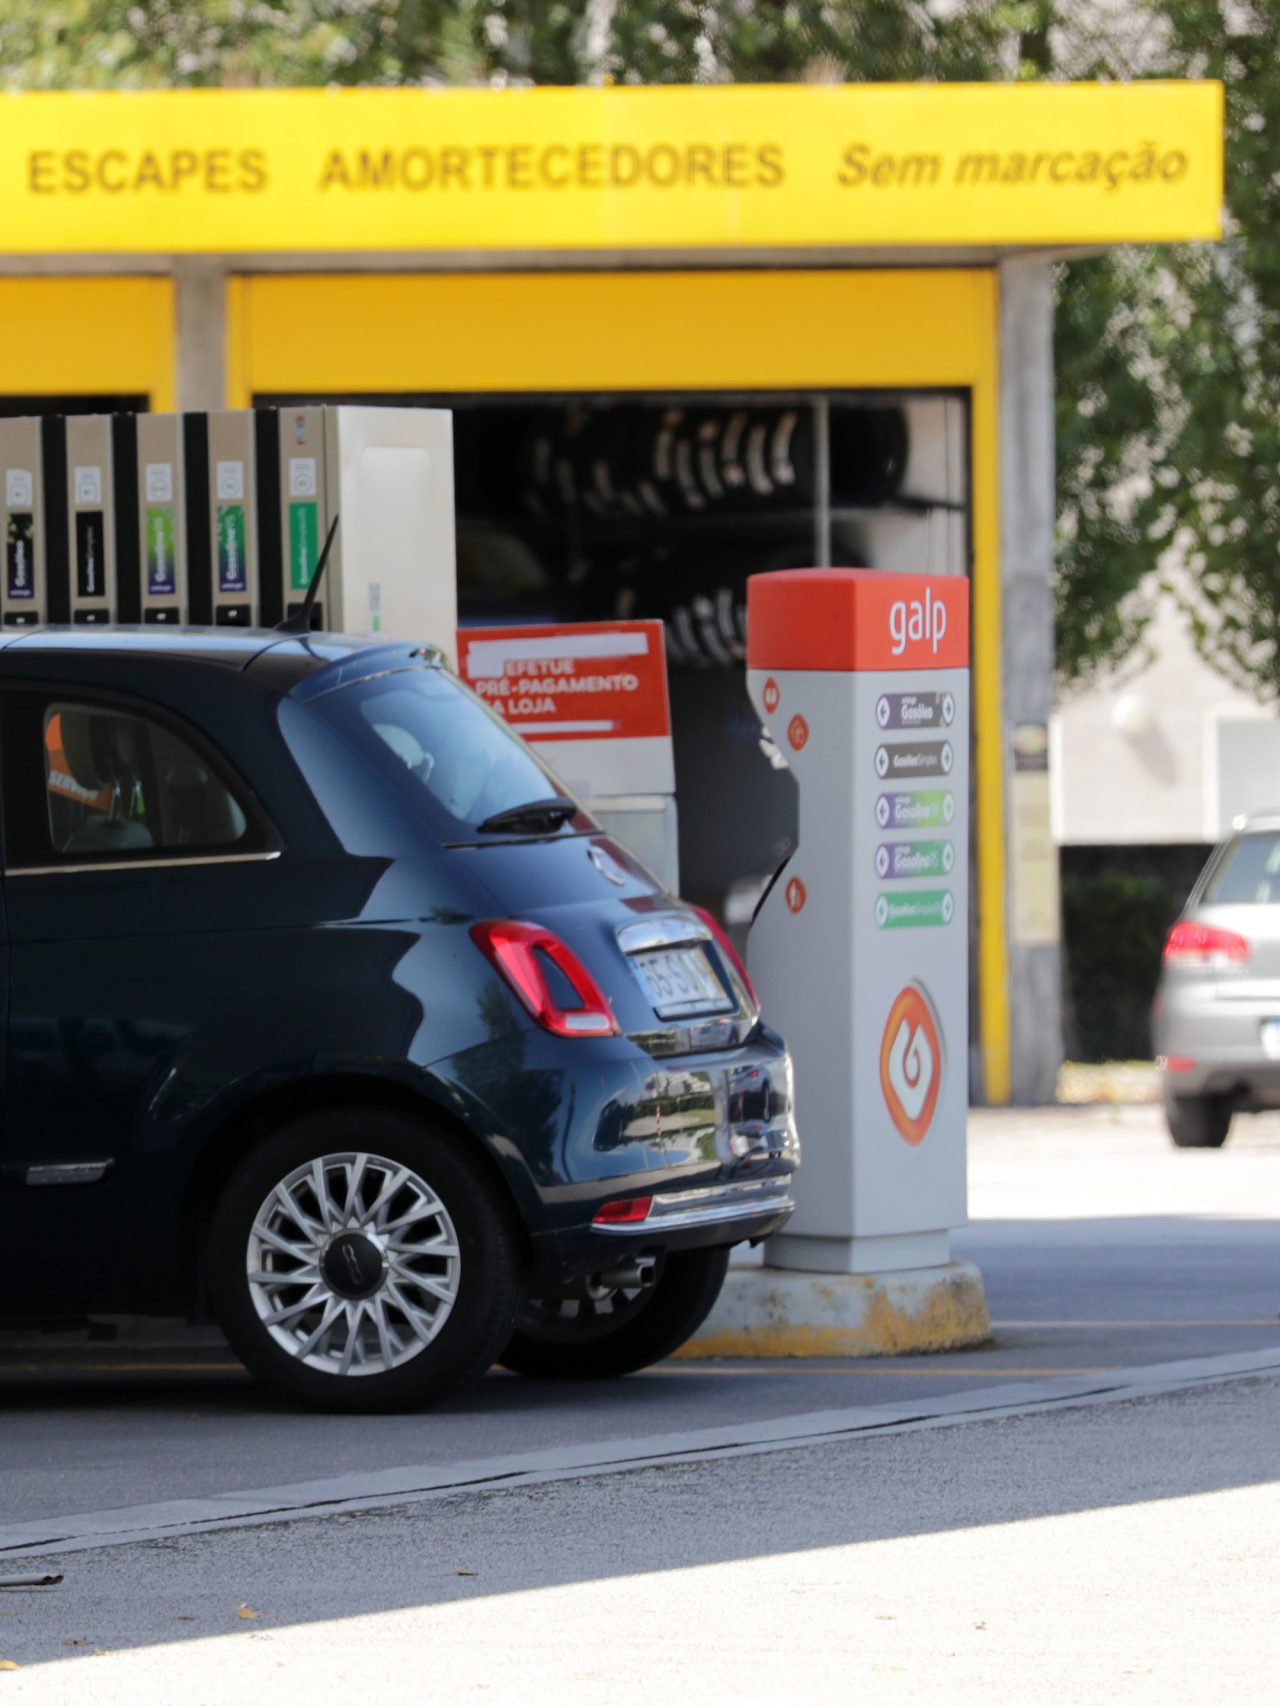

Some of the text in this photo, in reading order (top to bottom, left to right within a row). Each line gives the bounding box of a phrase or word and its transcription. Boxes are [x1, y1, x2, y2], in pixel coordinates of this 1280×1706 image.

[28, 148, 269, 195] ESCAPES
[318, 144, 785, 191] AMORTECEDORES
[836, 144, 941, 188] Sem
[953, 138, 1189, 196] marcação
[888, 586, 948, 655] galp
[504, 658, 575, 677] EFETUE
[475, 673, 640, 697] PRÉ-PAGAMENTO
[507, 697, 557, 716] LOJA
